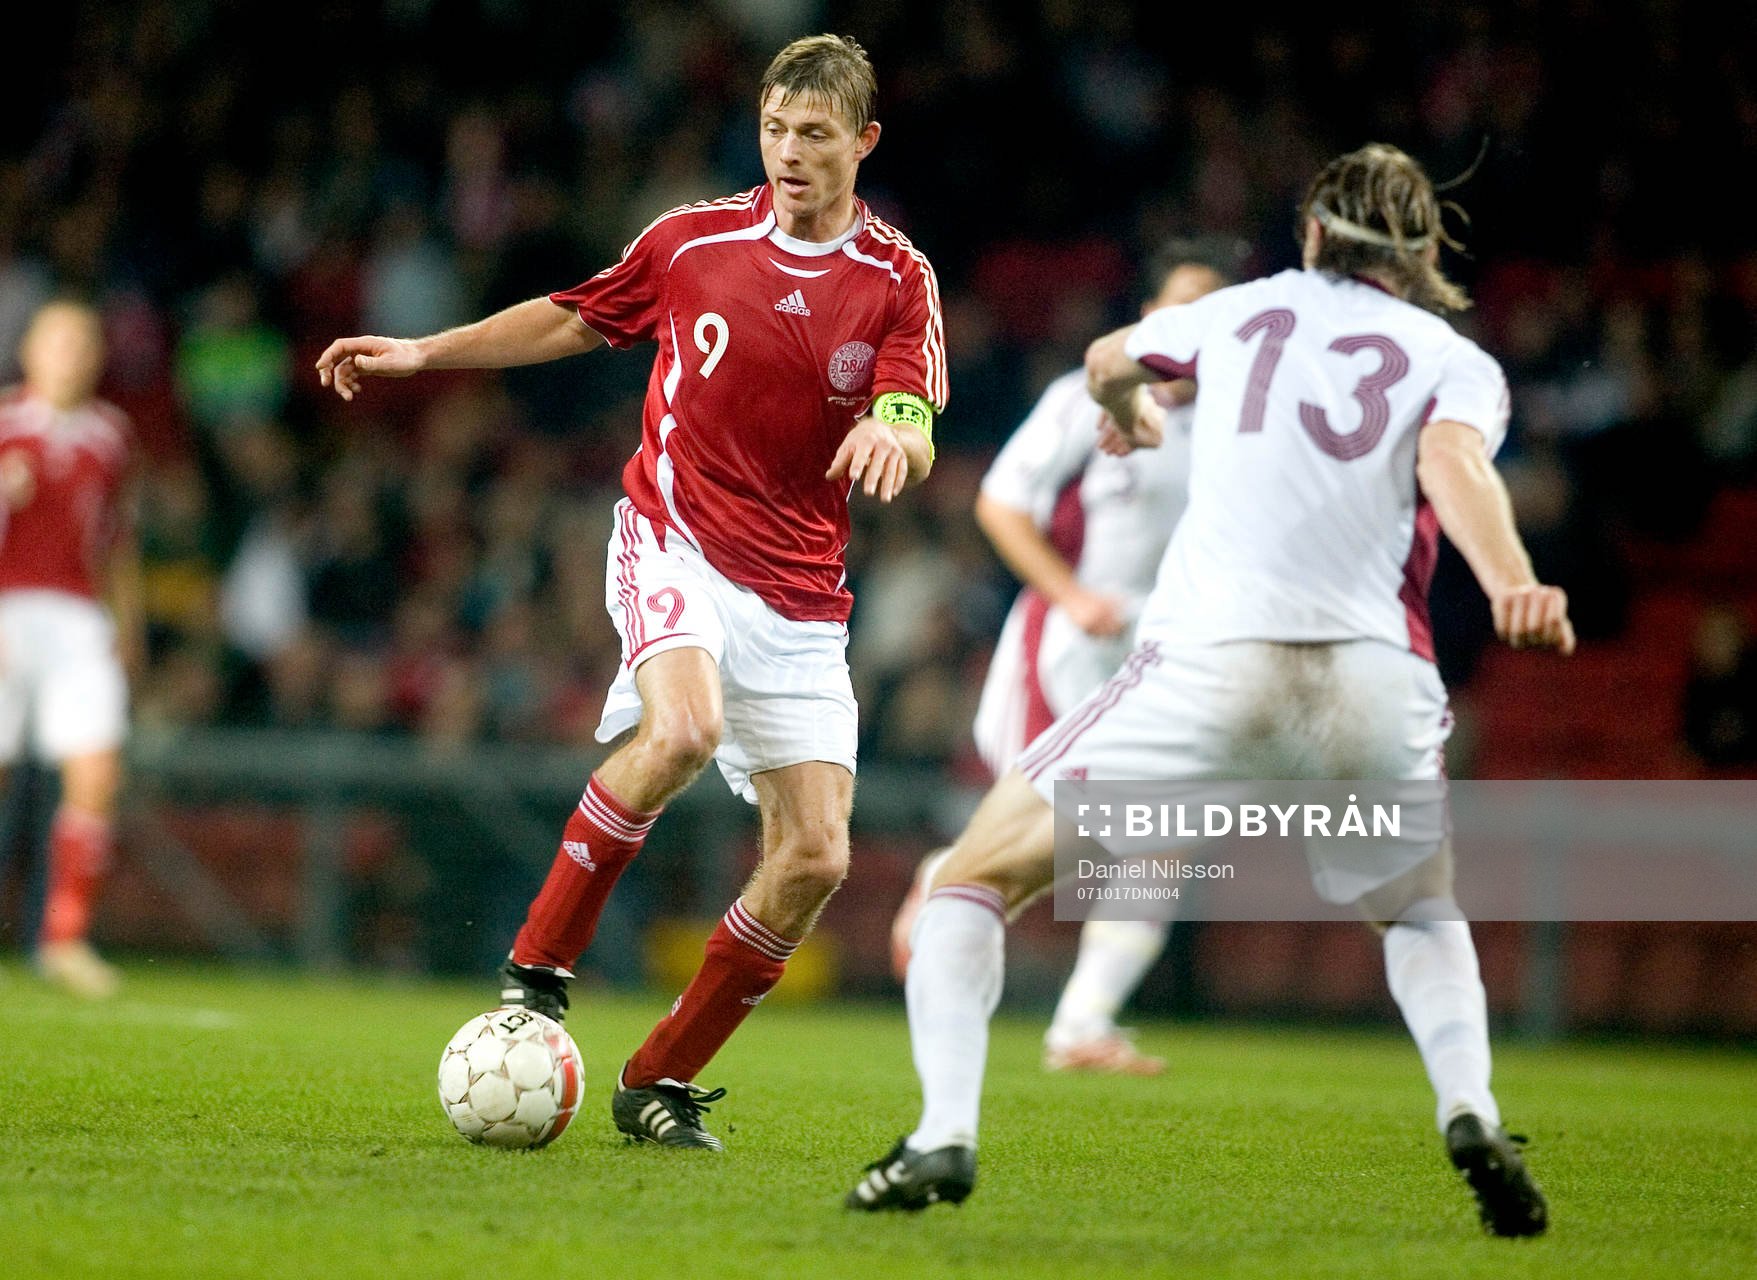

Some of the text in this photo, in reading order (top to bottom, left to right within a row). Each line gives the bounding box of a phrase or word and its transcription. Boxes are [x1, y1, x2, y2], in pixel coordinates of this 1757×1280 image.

[774, 303, 811, 317] adidas
[693, 312, 730, 379] 9
[840, 359, 867, 373] DBU
[1235, 308, 1410, 462] 13
[646, 586, 685, 630] 9
